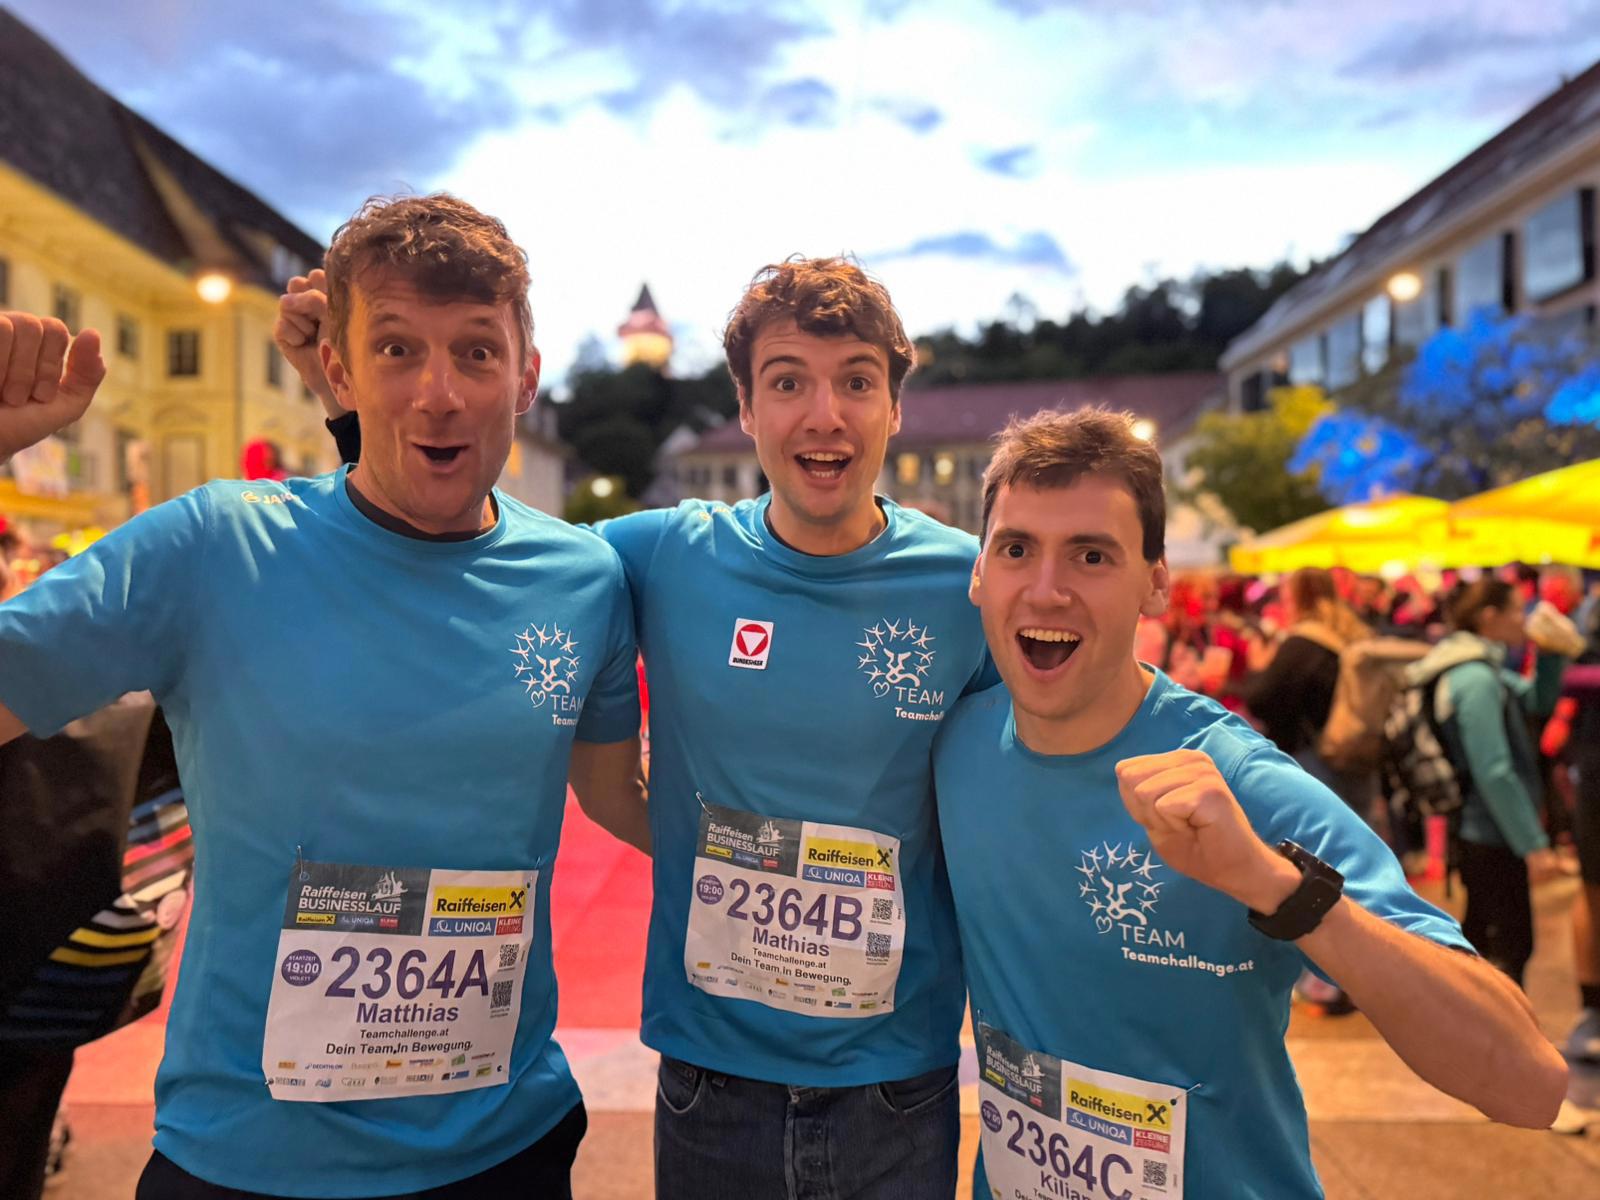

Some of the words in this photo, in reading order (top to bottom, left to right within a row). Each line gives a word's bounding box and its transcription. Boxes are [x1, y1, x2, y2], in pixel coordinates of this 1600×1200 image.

[550, 694, 585, 712] TEAM
[894, 686, 944, 705] TEAM
[708, 822, 753, 842] Raiffeisen
[706, 833, 781, 857] BUSINESSLAUF
[808, 848, 874, 867] Raiffeisen
[824, 870, 861, 884] UNIQA
[300, 885, 367, 900] Raiffeisen
[699, 883, 723, 896] 19:00
[298, 897, 401, 914] BUSINESSLAUF
[436, 897, 507, 912] Raiffeisen
[726, 878, 863, 941] 2364B
[454, 921, 492, 933] UNIQA
[1117, 922, 1185, 949] TEAM
[752, 926, 830, 957] Mathias
[286, 962, 320, 974] 19:00
[753, 947, 827, 969] Teamchallenge.at
[1121, 947, 1254, 977] Teamchallenge.at
[324, 946, 489, 1000] 2364A
[730, 952, 752, 966] Dein
[795, 968, 852, 986] Bewegung.
[356, 1002, 459, 1024] Matthias
[360, 1028, 449, 1039] Teamchallenge.at
[326, 1043, 356, 1055] Dein
[986, 1055, 1042, 1094] BUSINESSLAUF
[1070, 1090, 1143, 1123] Raiffeisen
[1088, 1119, 1128, 1141] UNIQA
[1006, 1109, 1133, 1200] 2364C
